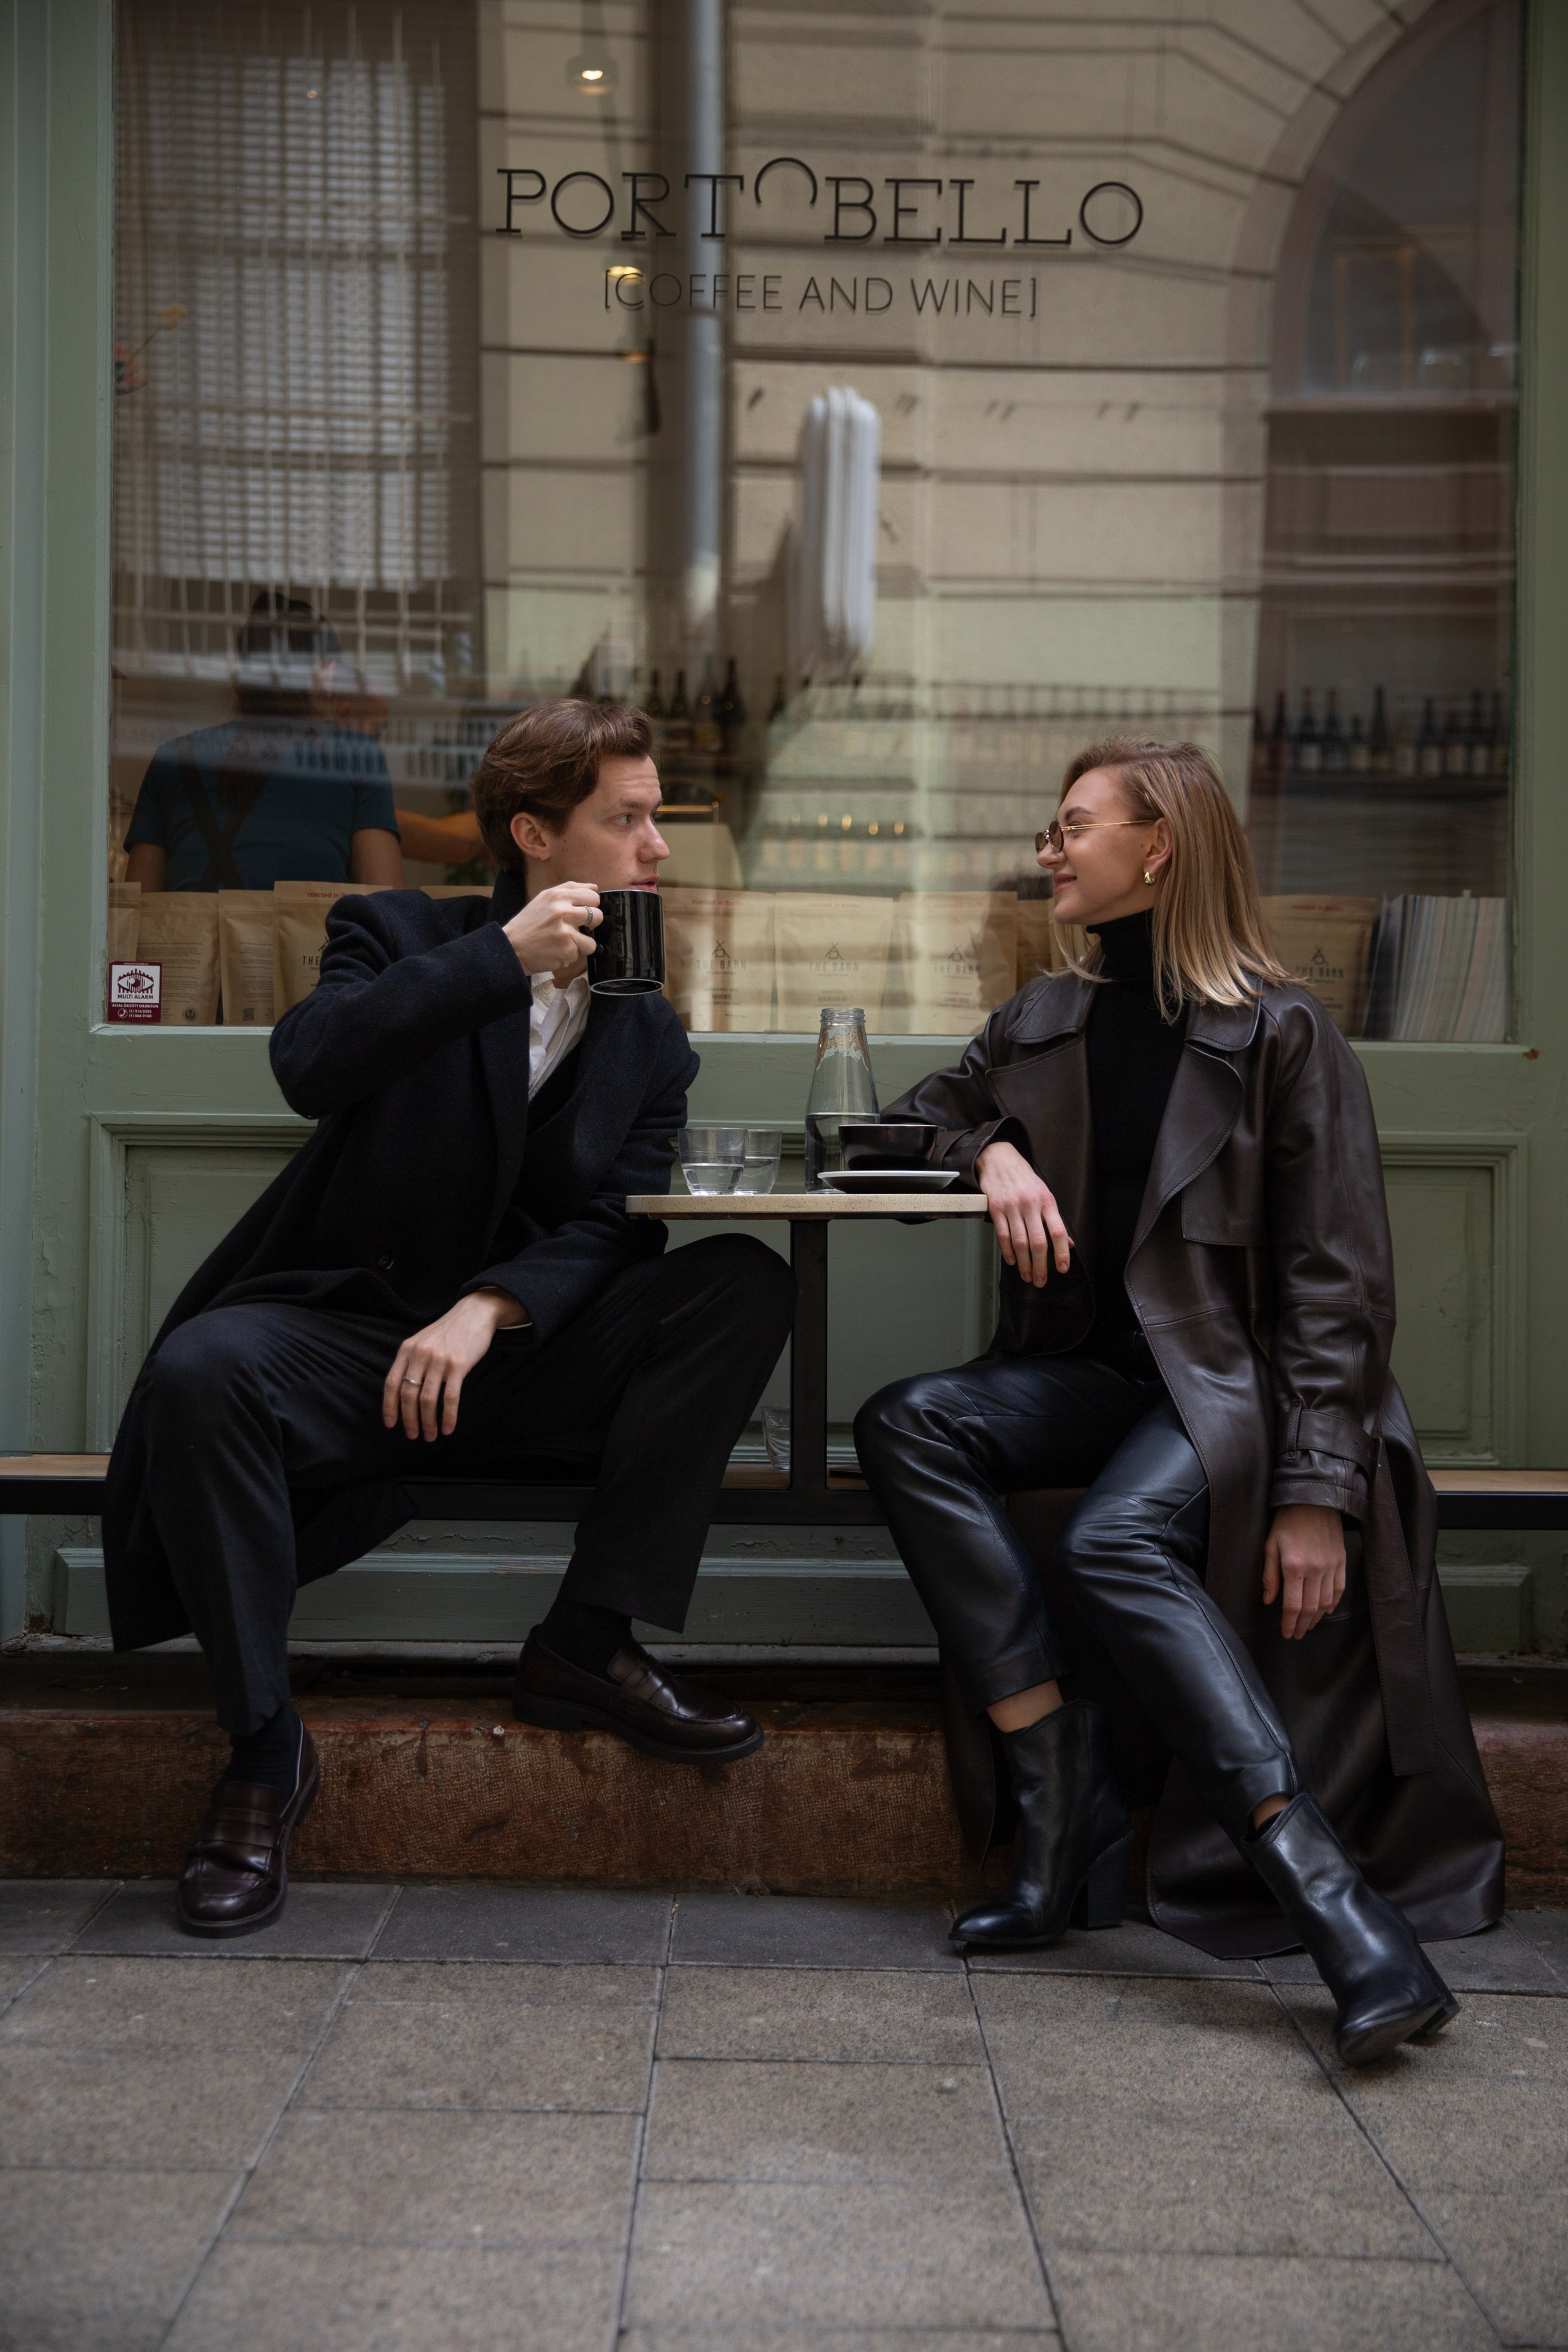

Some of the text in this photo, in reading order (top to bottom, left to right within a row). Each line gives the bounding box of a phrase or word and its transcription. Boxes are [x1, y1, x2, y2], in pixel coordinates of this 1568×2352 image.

[495, 156, 1144, 245] PORTOBELLO
[799, 275, 894, 312] AND
[910, 277, 1037, 317] WINE]
[303, 956, 320, 965] THE
[696, 960, 746, 970] THE BARN
[809, 962, 859, 972] THE BARN
